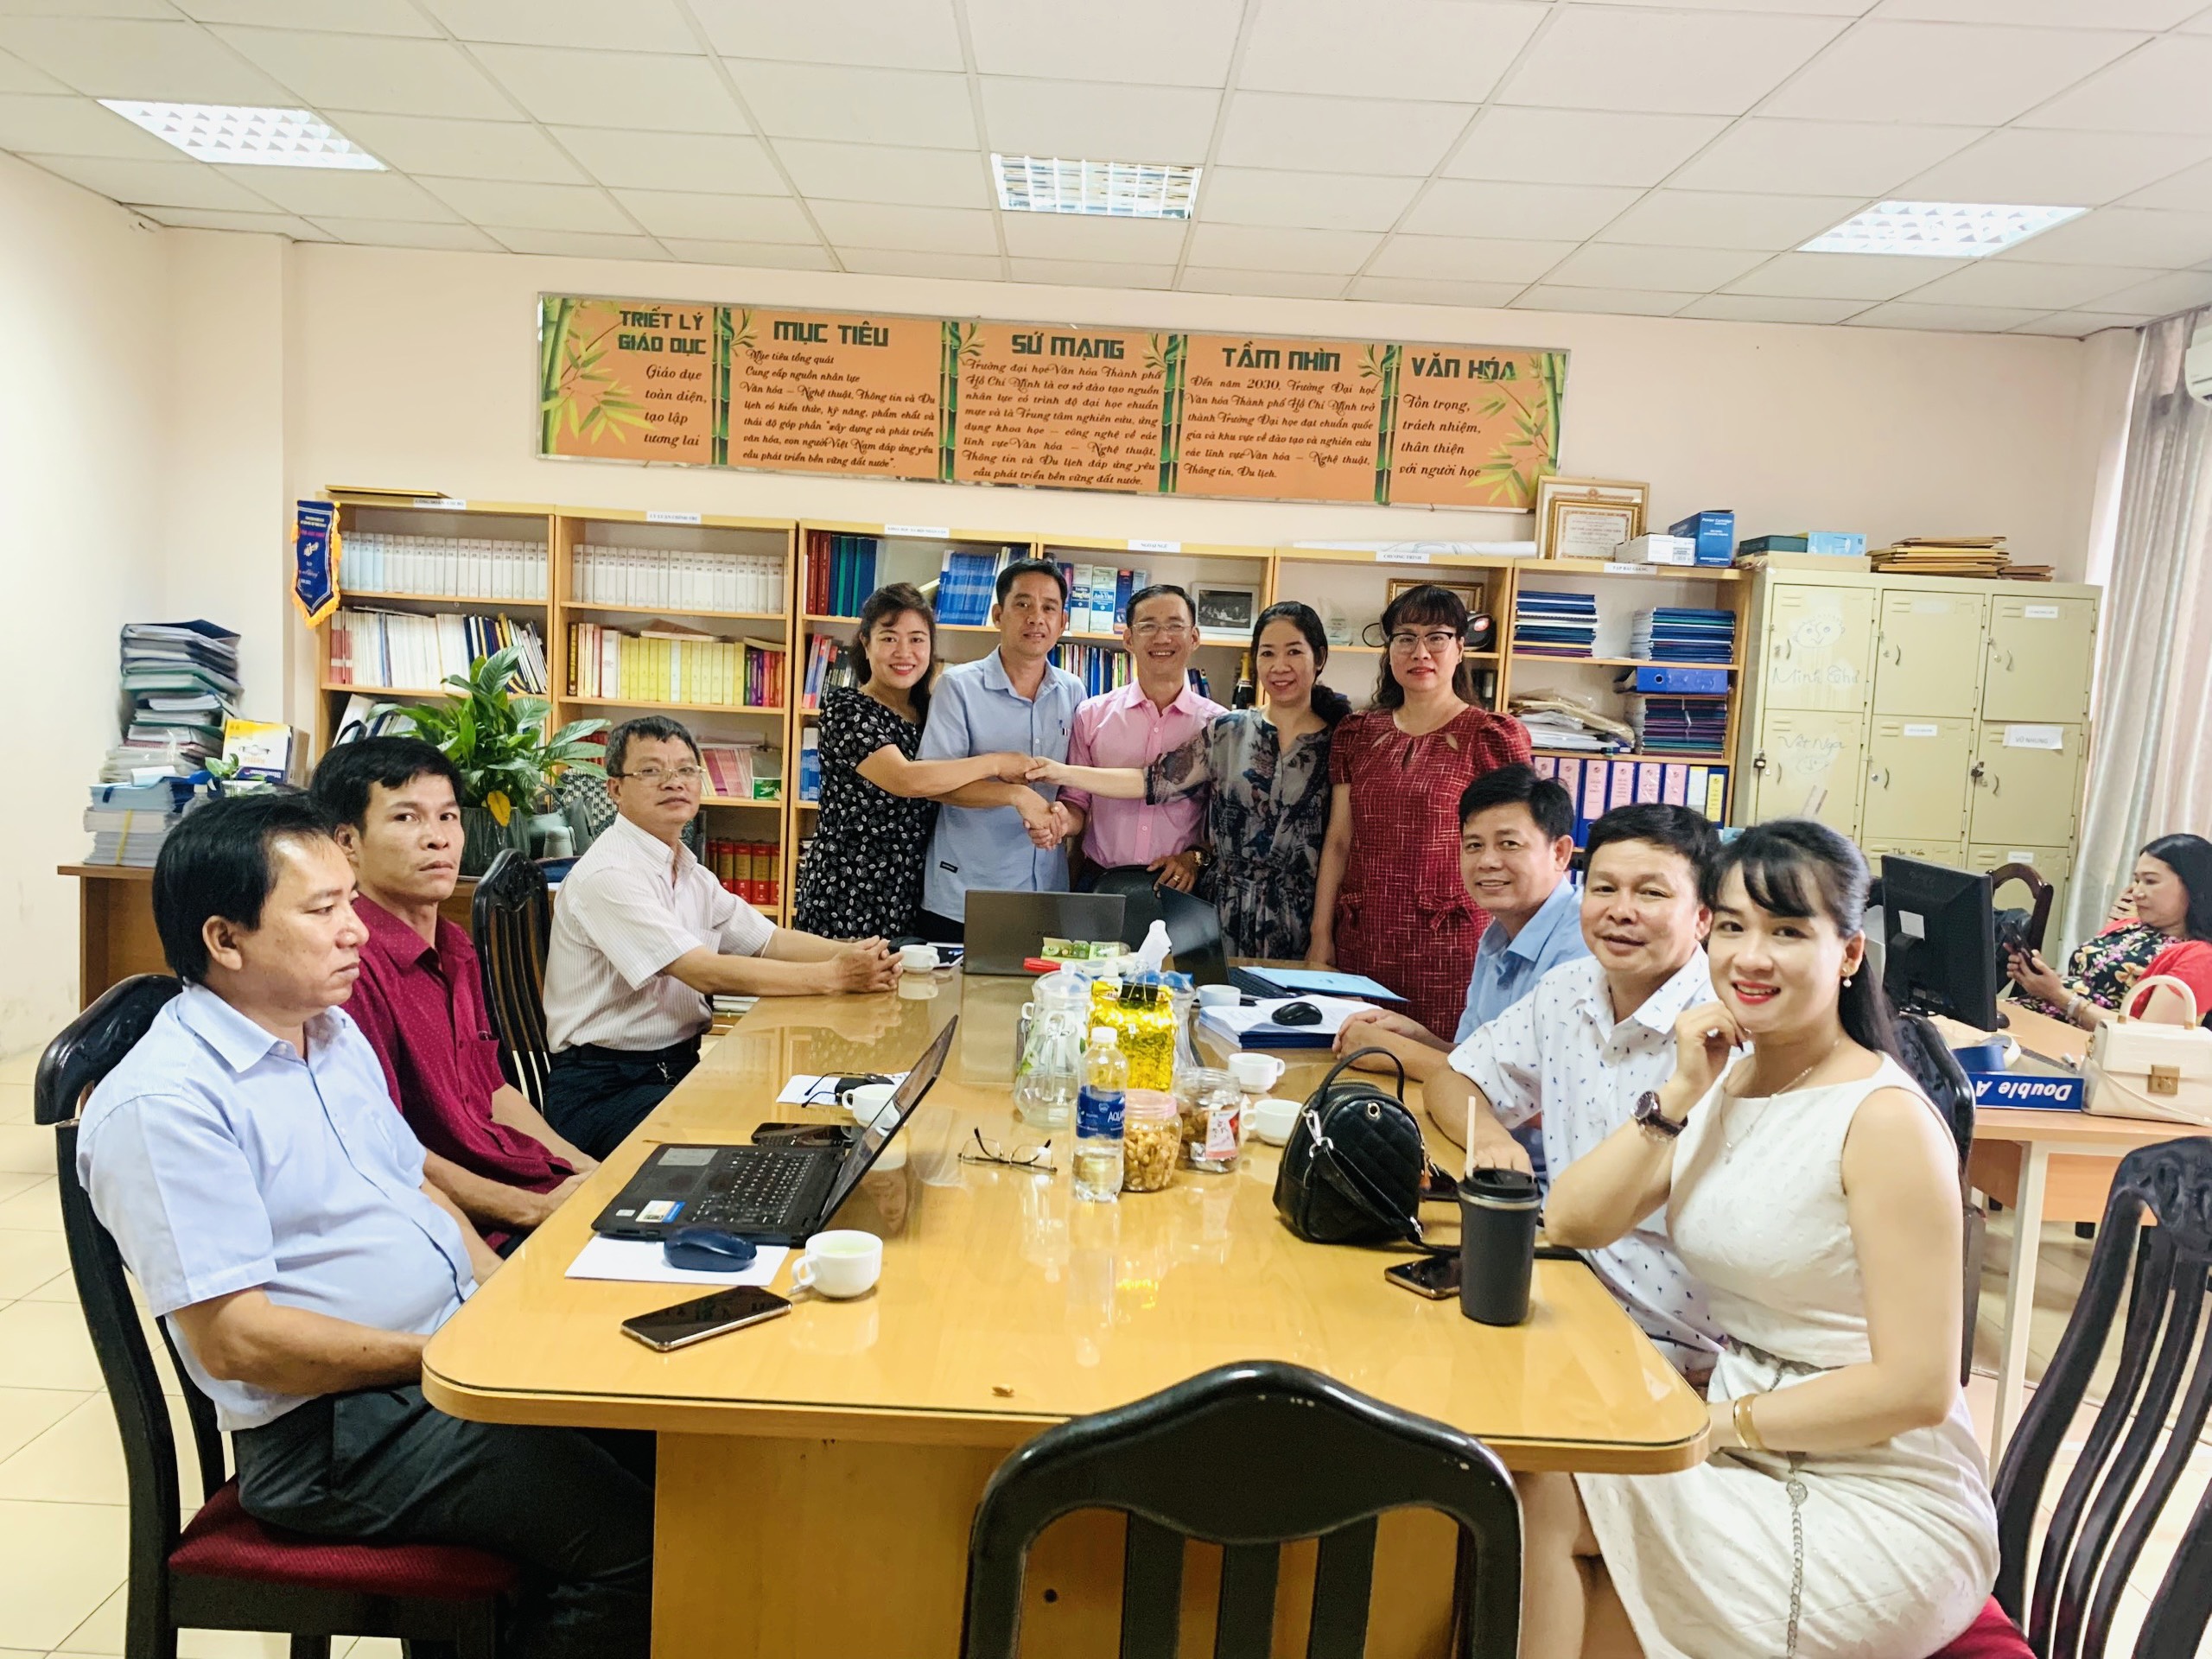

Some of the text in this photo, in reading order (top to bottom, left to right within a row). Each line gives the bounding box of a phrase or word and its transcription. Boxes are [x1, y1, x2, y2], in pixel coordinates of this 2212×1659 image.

[620, 307, 703, 330] TRIẾT LÝ
[774, 321, 888, 346] MỤC TIÊU
[619, 333, 707, 356] GIÁO DỤC
[1012, 331, 1124, 360] SỨ MẠNG
[747, 349, 834, 365] Mục tiêu tổng quát
[1222, 340, 1340, 372] TẦM NHÌN
[646, 365, 702, 381] Giáo dục
[746, 366, 770, 379] Cung
[772, 368, 787, 379] cấp
[790, 370, 817, 381] nguồn
[847, 374, 860, 384] lực
[966, 359, 1161, 380] Trường đại học Văn hóa Thành phố
[1411, 353, 1516, 380] VĂN HÓA
[740, 382, 763, 393] Văn
[766, 385, 783, 394] hóa
[798, 385, 825, 401] Nghệ
[855, 389, 887, 403] Thông
[889, 393, 901, 402] tin
[905, 394, 914, 403] và
[918, 393, 935, 404] Du
[966, 374, 984, 390] Hồ
[988, 377, 1006, 386] Chí
[1009, 377, 1039, 392] Minh
[1044, 380, 1054, 389] là
[1071, 382, 1084, 391] sở
[1085, 383, 1104, 391] đào
[1108, 385, 1124, 394] tạo
[1128, 385, 1159, 397] nguồn
[1191, 375, 1212, 386] Đến
[1287, 379, 1325, 394] Trường
[1331, 382, 1351, 394] Đại
[1359, 384, 1376, 395] học
[645, 389, 707, 404] toàn diện,
[1184, 392, 1375, 416] Văn hóa Thành phố Hồ Chí Minh trở
[1403, 394, 1470, 414] Tôn trọng,
[645, 412, 688, 426] tạo lập
[745, 401, 760, 410] lịch
[779, 403, 798, 411] kiến
[828, 406, 839, 416] kỹ
[871, 408, 897, 418] phẩm
[901, 410, 920, 419] chất
[744, 417, 762, 426] thái
[766, 419, 777, 428] độ
[779, 420, 796, 430] góp
[798, 420, 821, 430] phần
[849, 424, 873, 435] dựng
[888, 427, 909, 436] phát
[912, 427, 933, 437] triển
[1188, 411, 1373, 430] thành Trường Đại học đạt chuẩn quốc
[1402, 419, 1480, 434] trách nhiệm,
[645, 434, 700, 448] tương lai
[803, 437, 828, 448] người
[826, 437, 849, 449] Việt
[850, 439, 875, 454] Nam
[879, 442, 896, 454] đáp
[899, 443, 915, 455] ứng
[915, 446, 933, 455] yêu
[1401, 442, 1464, 455] thân thiện
[743, 449, 759, 459] cầu
[760, 452, 782, 461] phát
[784, 452, 805, 462] triển
[808, 454, 823, 463] bền
[826, 457, 848, 467] vững
[850, 457, 866, 466] đất
[973, 467, 990, 477] cầu
[994, 469, 1017, 479] phát
[1020, 470, 1044, 479] triển
[1048, 471, 1065, 480] bền
[1069, 473, 1093, 484] vững
[1096, 473, 1113, 483] đất
[1184, 463, 1216, 478] Thông
[1237, 466, 1255, 477] Du
[1399, 463, 1480, 478] với người học
[1976, 1081, 2073, 1102] Double A
